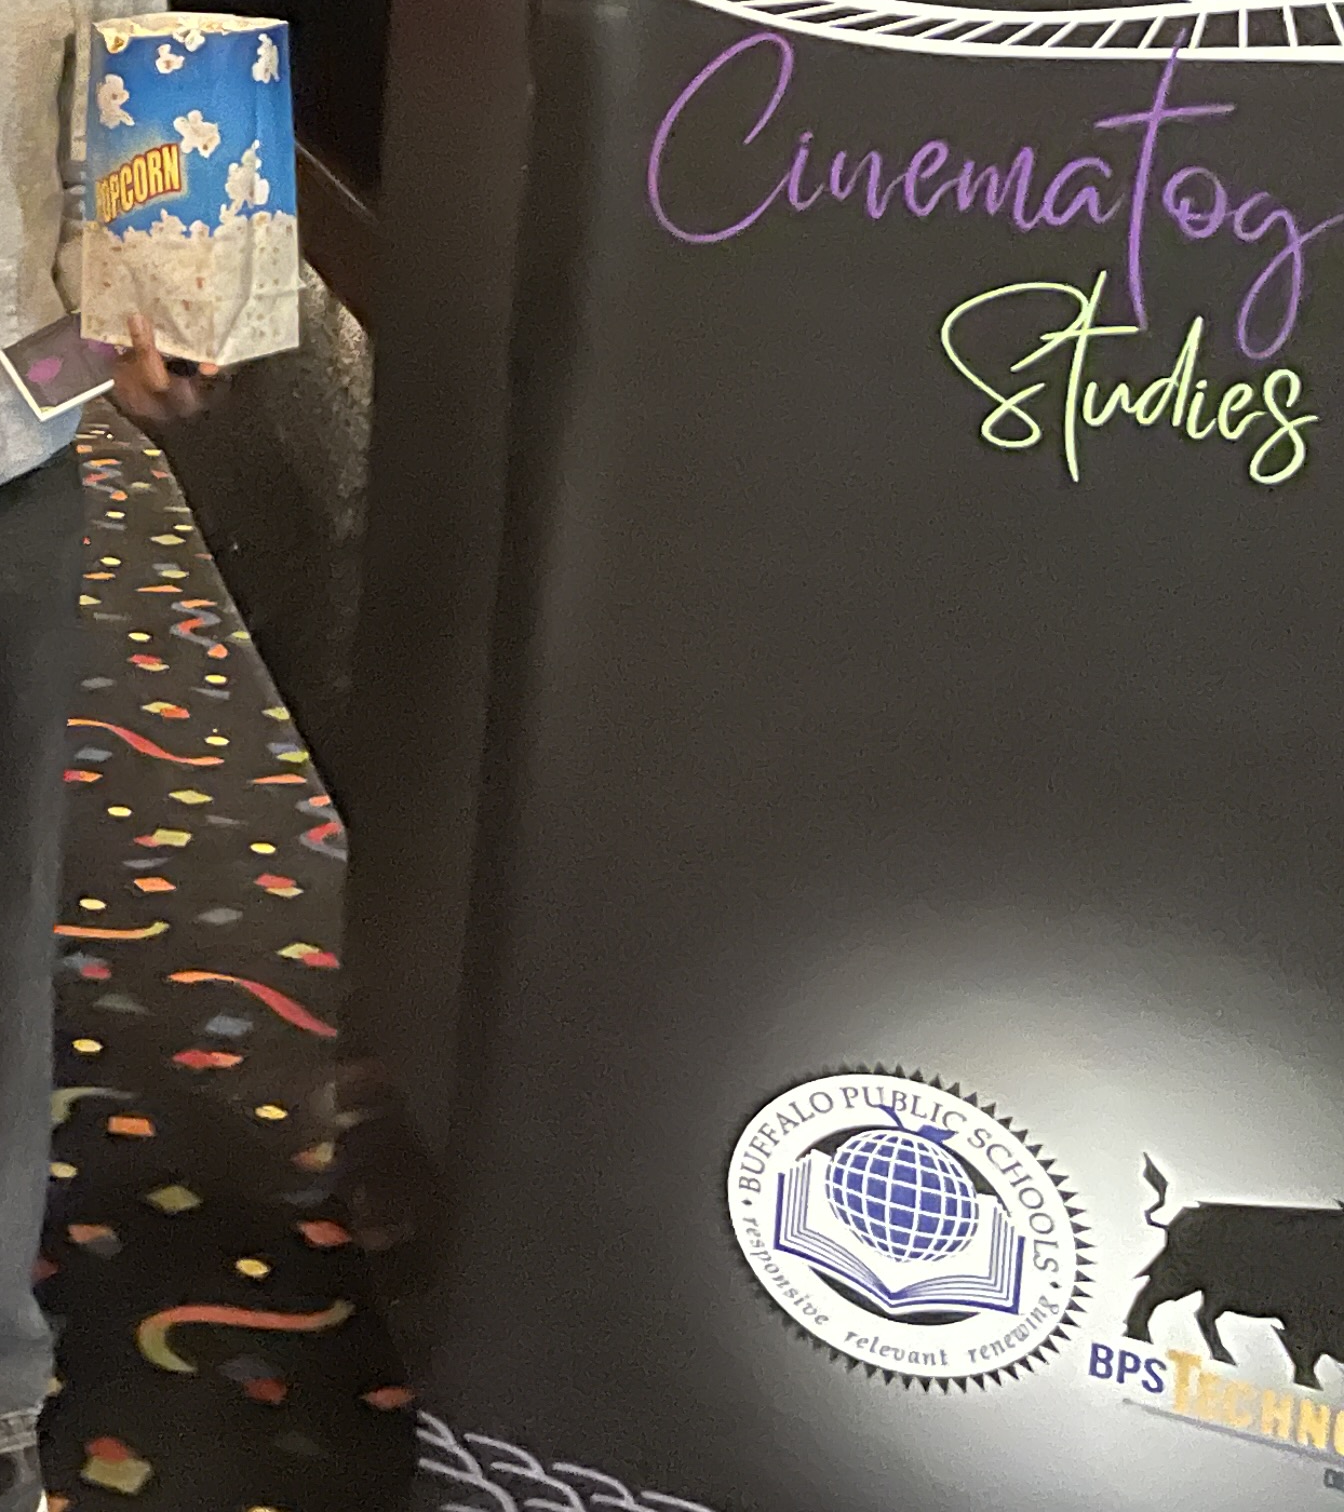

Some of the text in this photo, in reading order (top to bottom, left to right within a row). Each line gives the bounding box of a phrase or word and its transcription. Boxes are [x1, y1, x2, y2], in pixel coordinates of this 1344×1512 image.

[941, 270, 1319, 484] Studies
[738, 1086, 1060, 1273] BUFFALO PUBLIC SCHOOLS
[742, 1216, 1060, 1367] responsive relevant renewing
